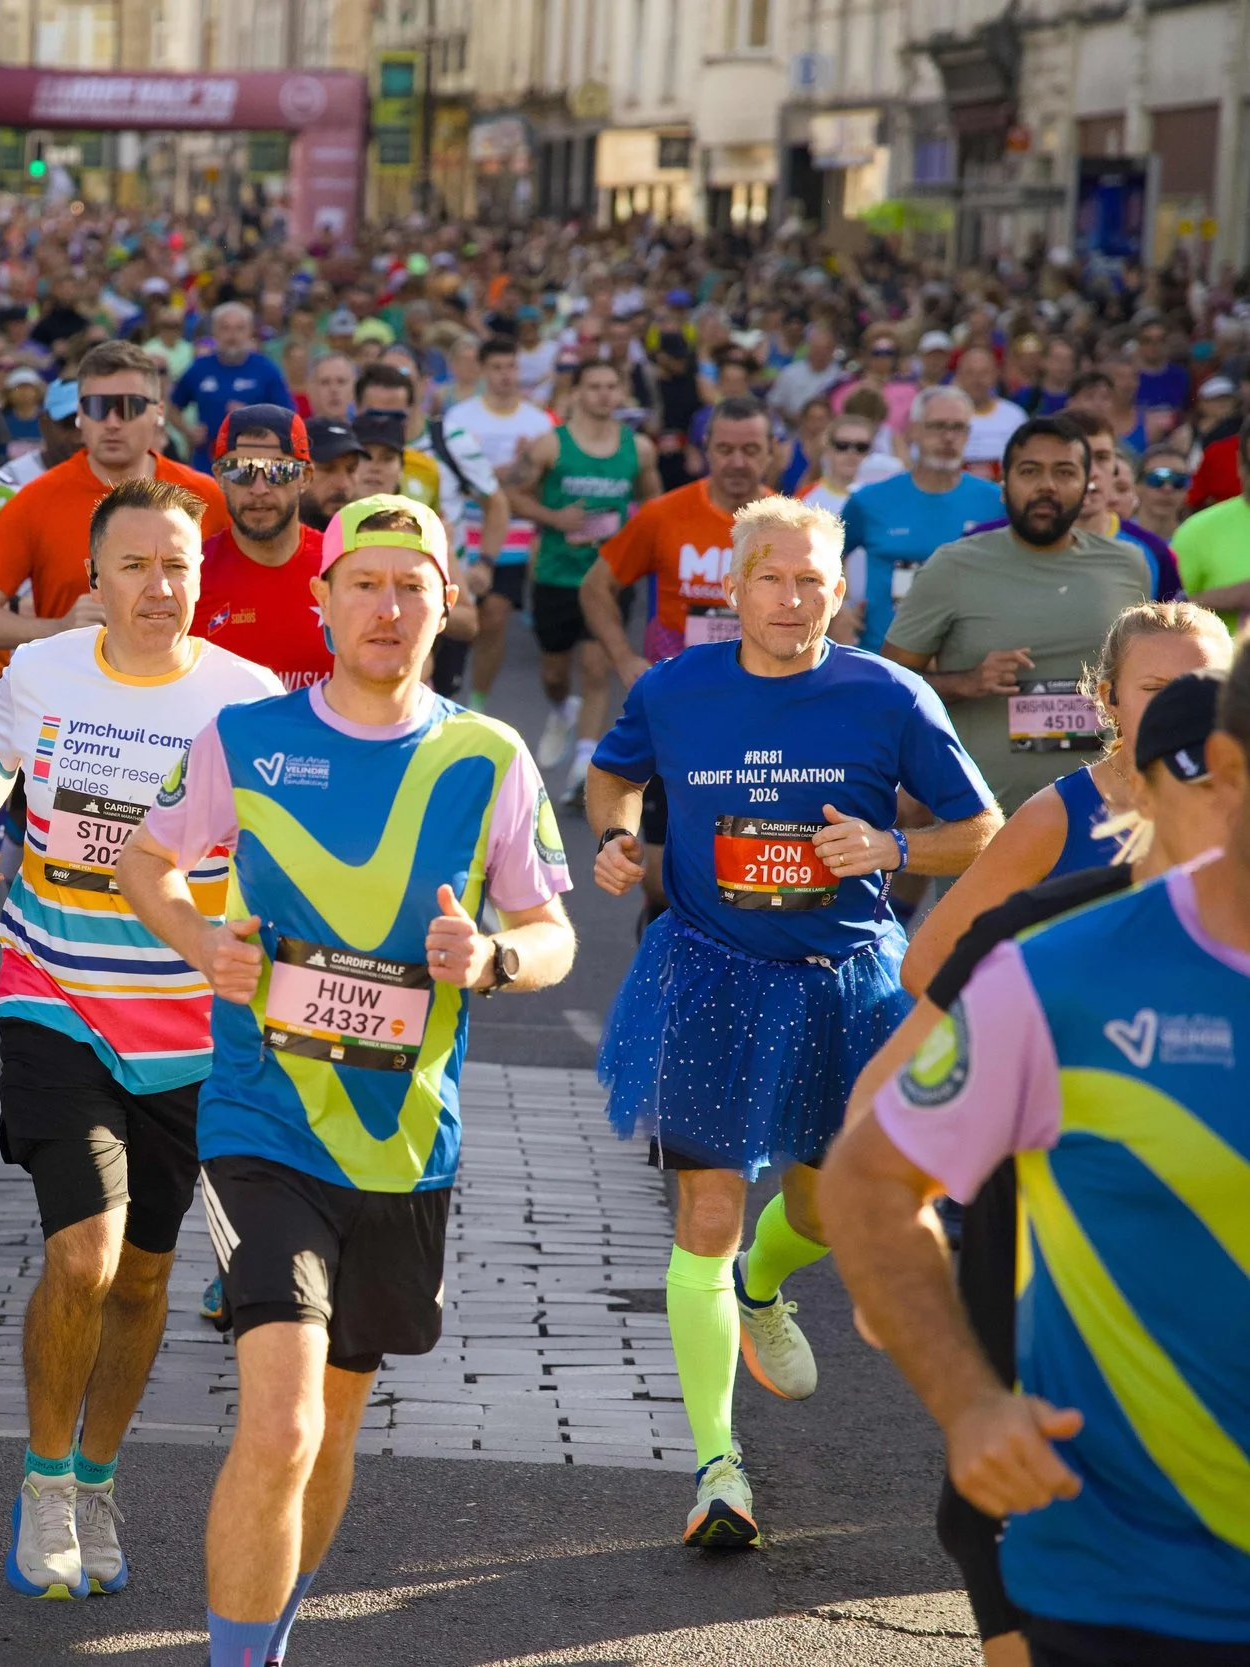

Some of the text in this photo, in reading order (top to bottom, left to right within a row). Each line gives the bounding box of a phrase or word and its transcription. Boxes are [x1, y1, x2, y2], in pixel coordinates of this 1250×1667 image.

[67, 719, 145, 744] ymchwil
[1044, 715, 1085, 729] 4510
[63, 738, 121, 759] cymru
[743, 749, 783, 765] #RR81
[59, 757, 121, 778] cancer
[687, 768, 845, 786] CARDIFF HALF MARATHON
[56, 775, 109, 796] wales
[748, 788, 779, 803] 2026
[103, 801, 143, 816] CARDIFF
[761, 822, 798, 832] CARDIFF
[756, 845, 802, 863] JON
[744, 864, 812, 884] 21069
[331, 953, 406, 976] CARDIFF HALF
[317, 978, 383, 1010] HUW
[303, 1002, 386, 1037] 24337
